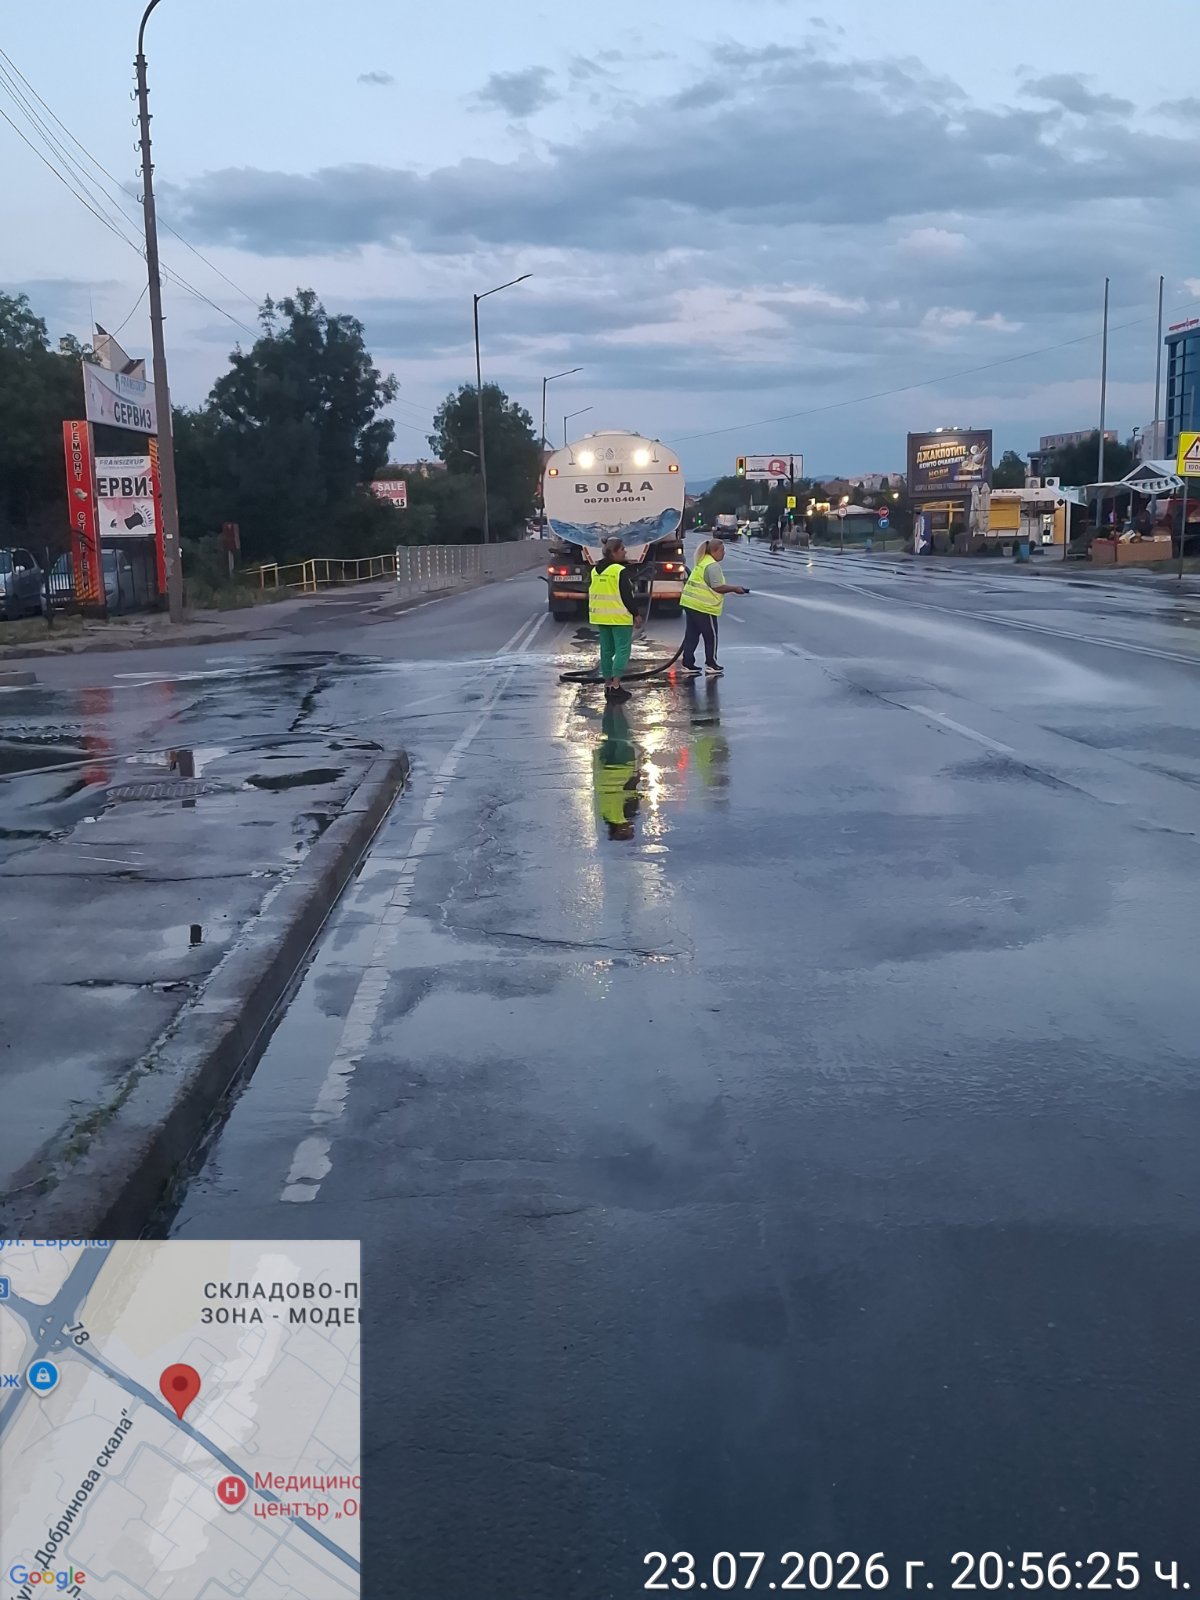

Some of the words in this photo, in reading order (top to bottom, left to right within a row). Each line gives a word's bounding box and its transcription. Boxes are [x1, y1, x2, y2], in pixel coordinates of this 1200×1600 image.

[114, 401, 152, 429] СЕРВИЗ
[71, 422, 82, 481] РЕМОНТ
[378, 482, 404, 491] SALE
[575, 481, 653, 493] ВОДА
